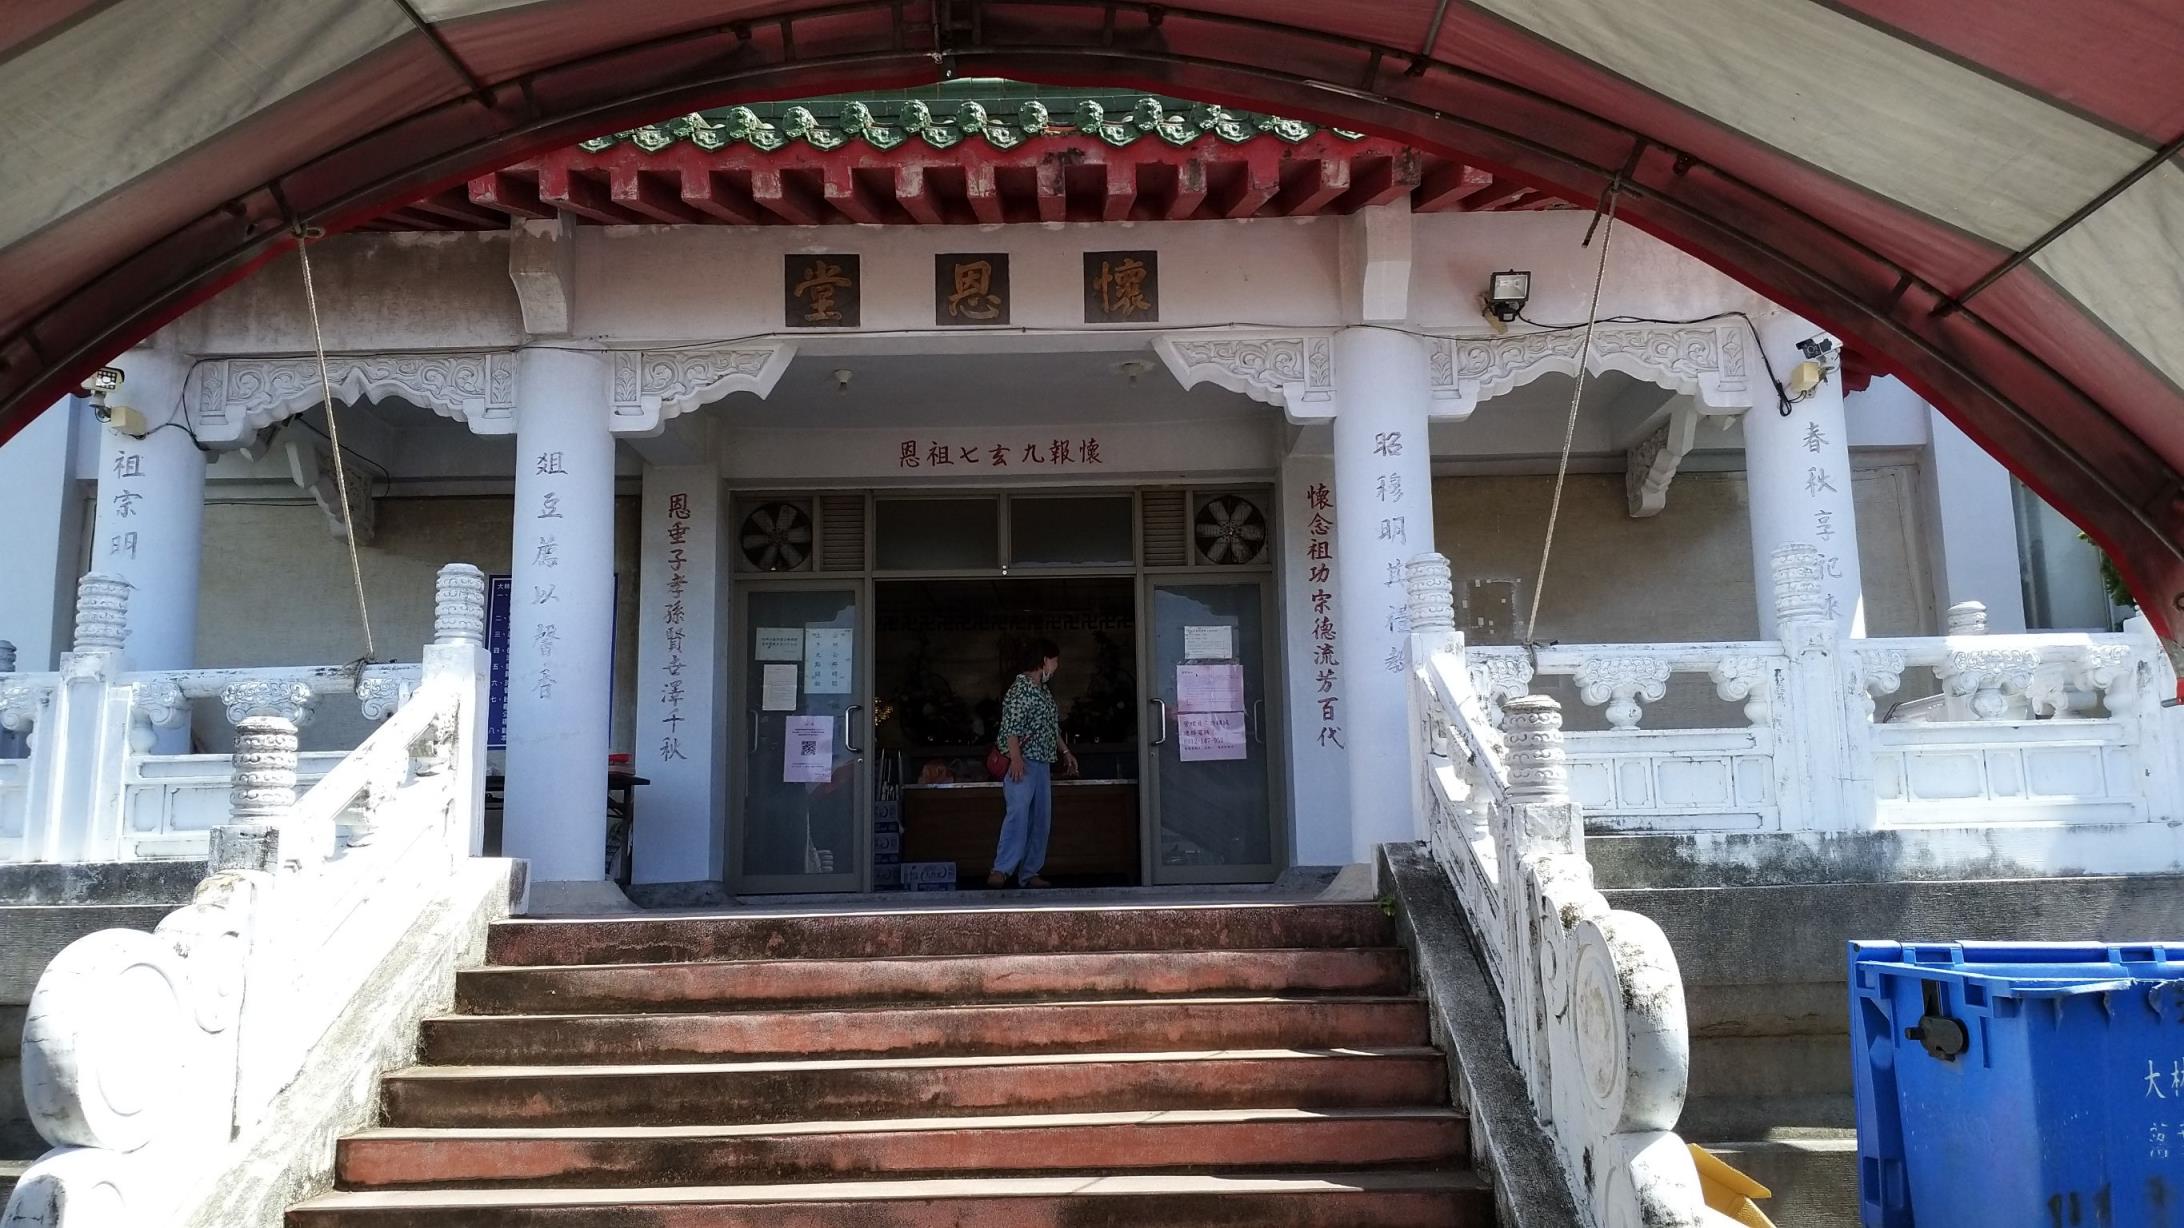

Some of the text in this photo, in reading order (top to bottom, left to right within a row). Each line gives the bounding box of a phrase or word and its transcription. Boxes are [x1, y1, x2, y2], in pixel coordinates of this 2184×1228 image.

[1306, 482, 1345, 750] 懷念祖功宗德流芳百代
